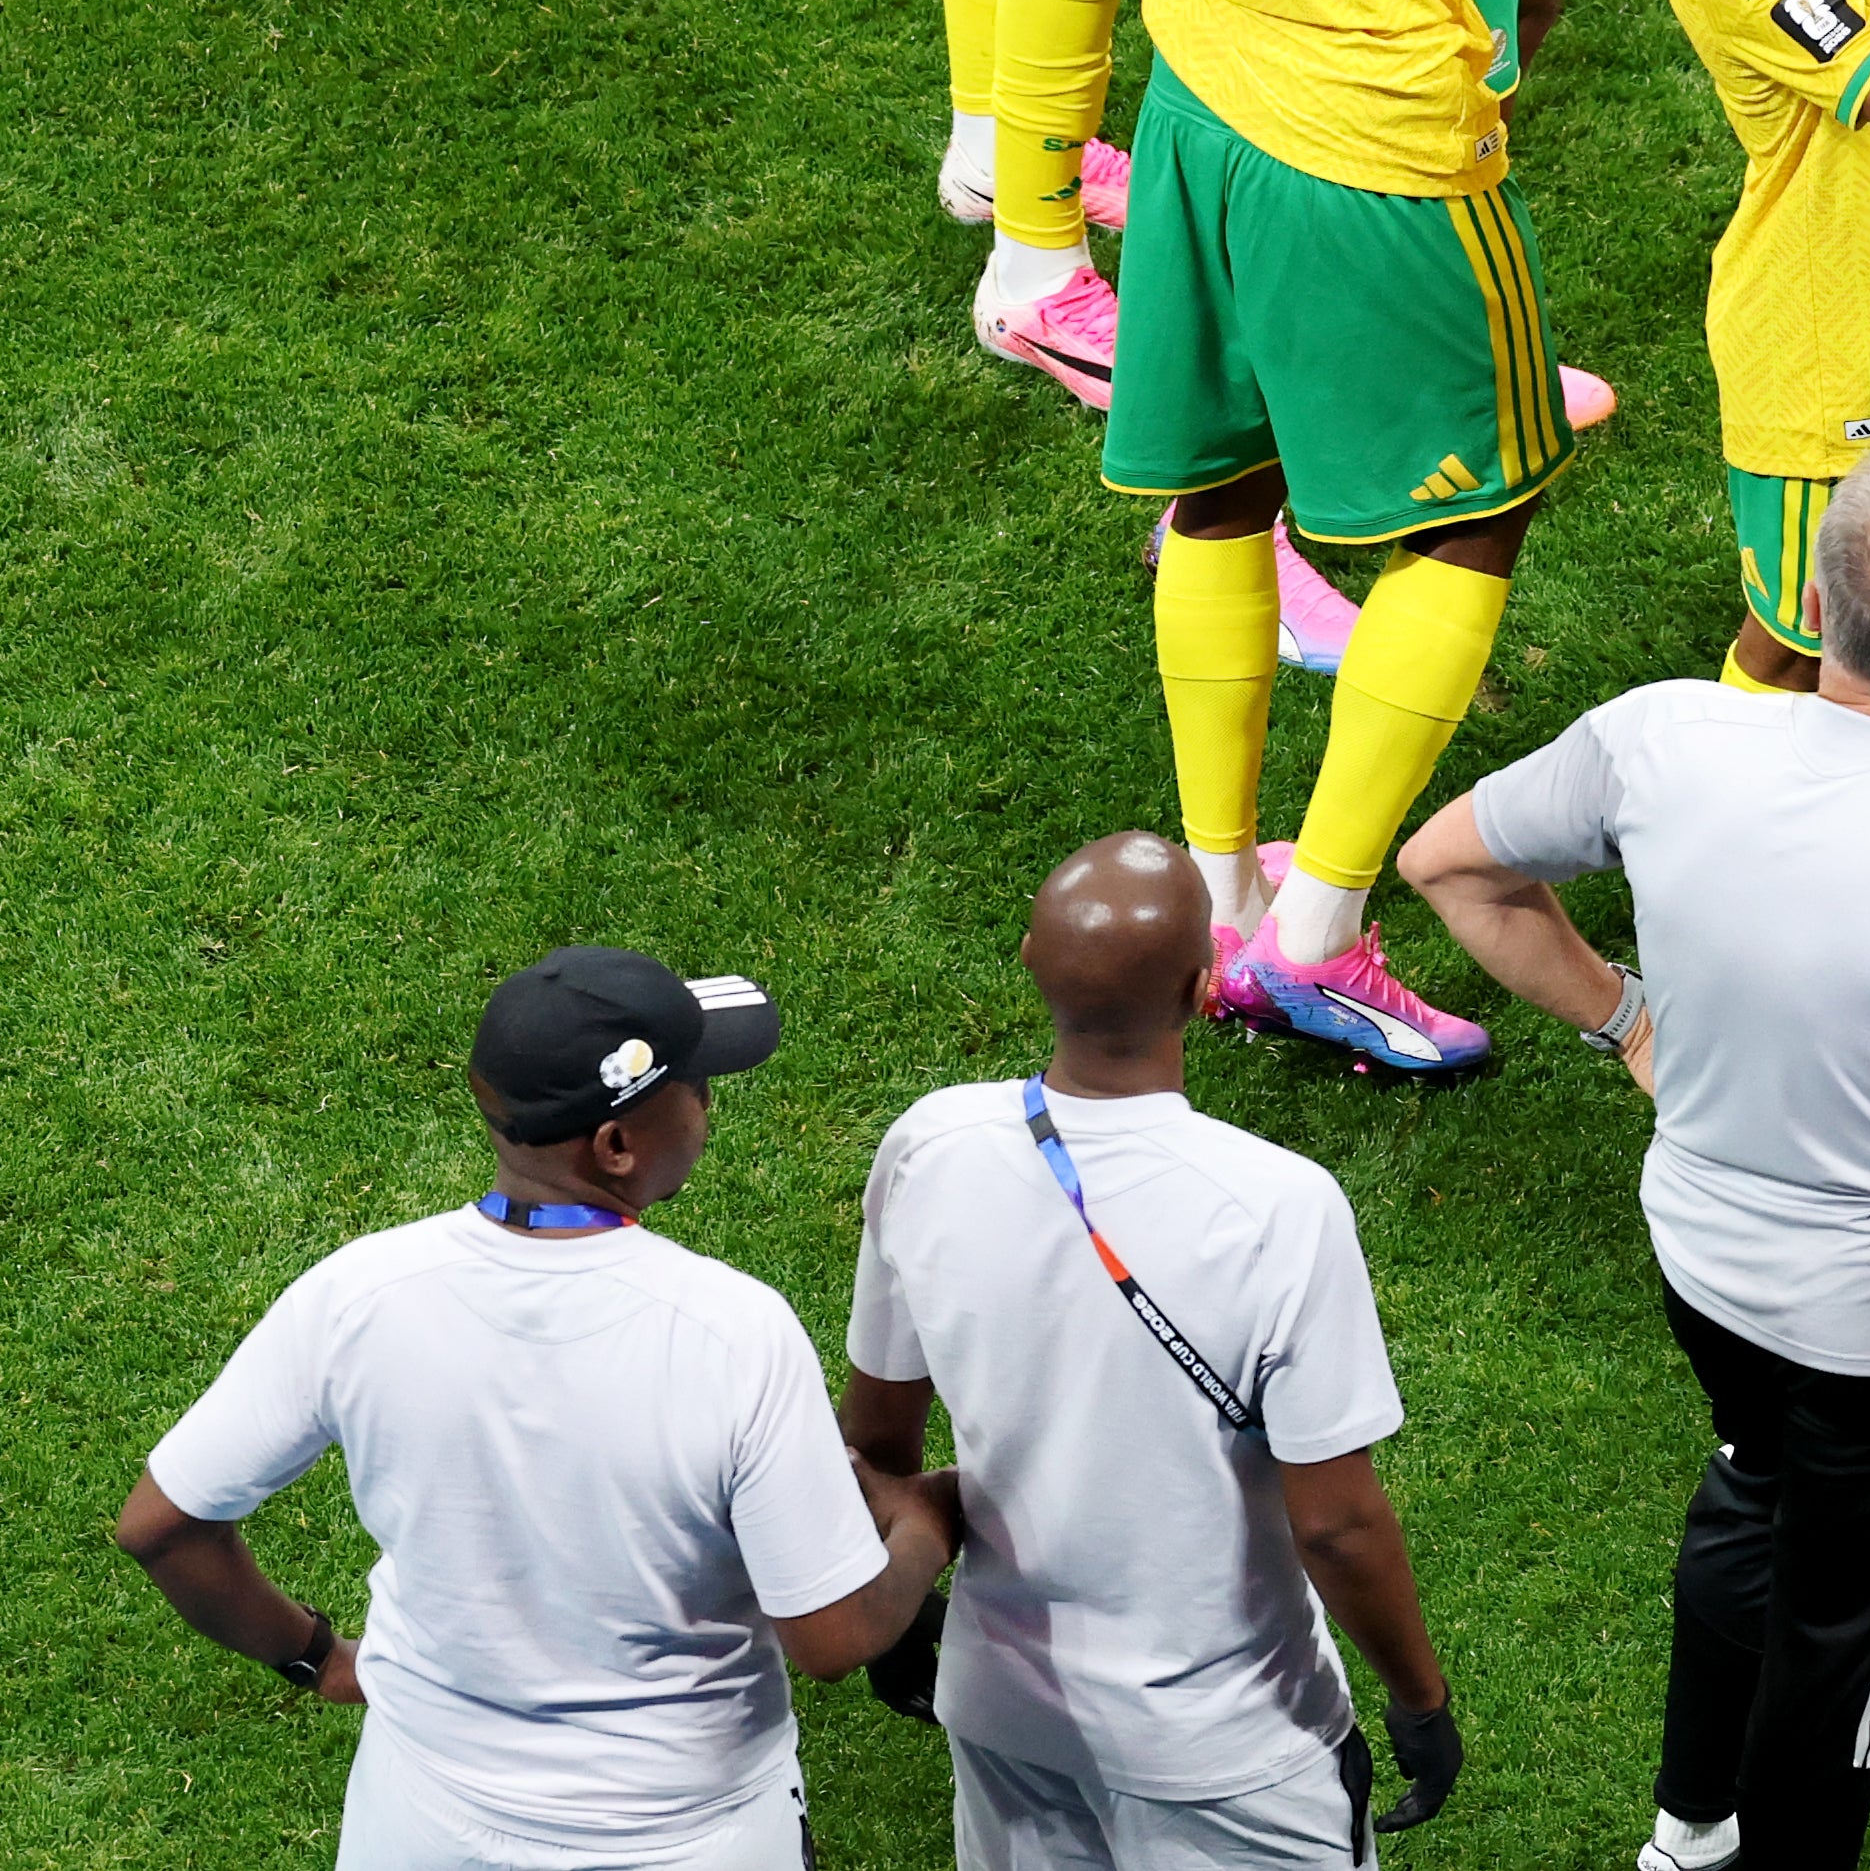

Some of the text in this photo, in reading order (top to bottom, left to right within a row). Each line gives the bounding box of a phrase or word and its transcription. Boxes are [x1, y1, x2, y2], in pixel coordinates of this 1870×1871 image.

[1132, 1292, 1176, 1342] 2026
[1169, 1340, 1196, 1366] CUP
[1191, 1362, 1230, 1406] WORLD
